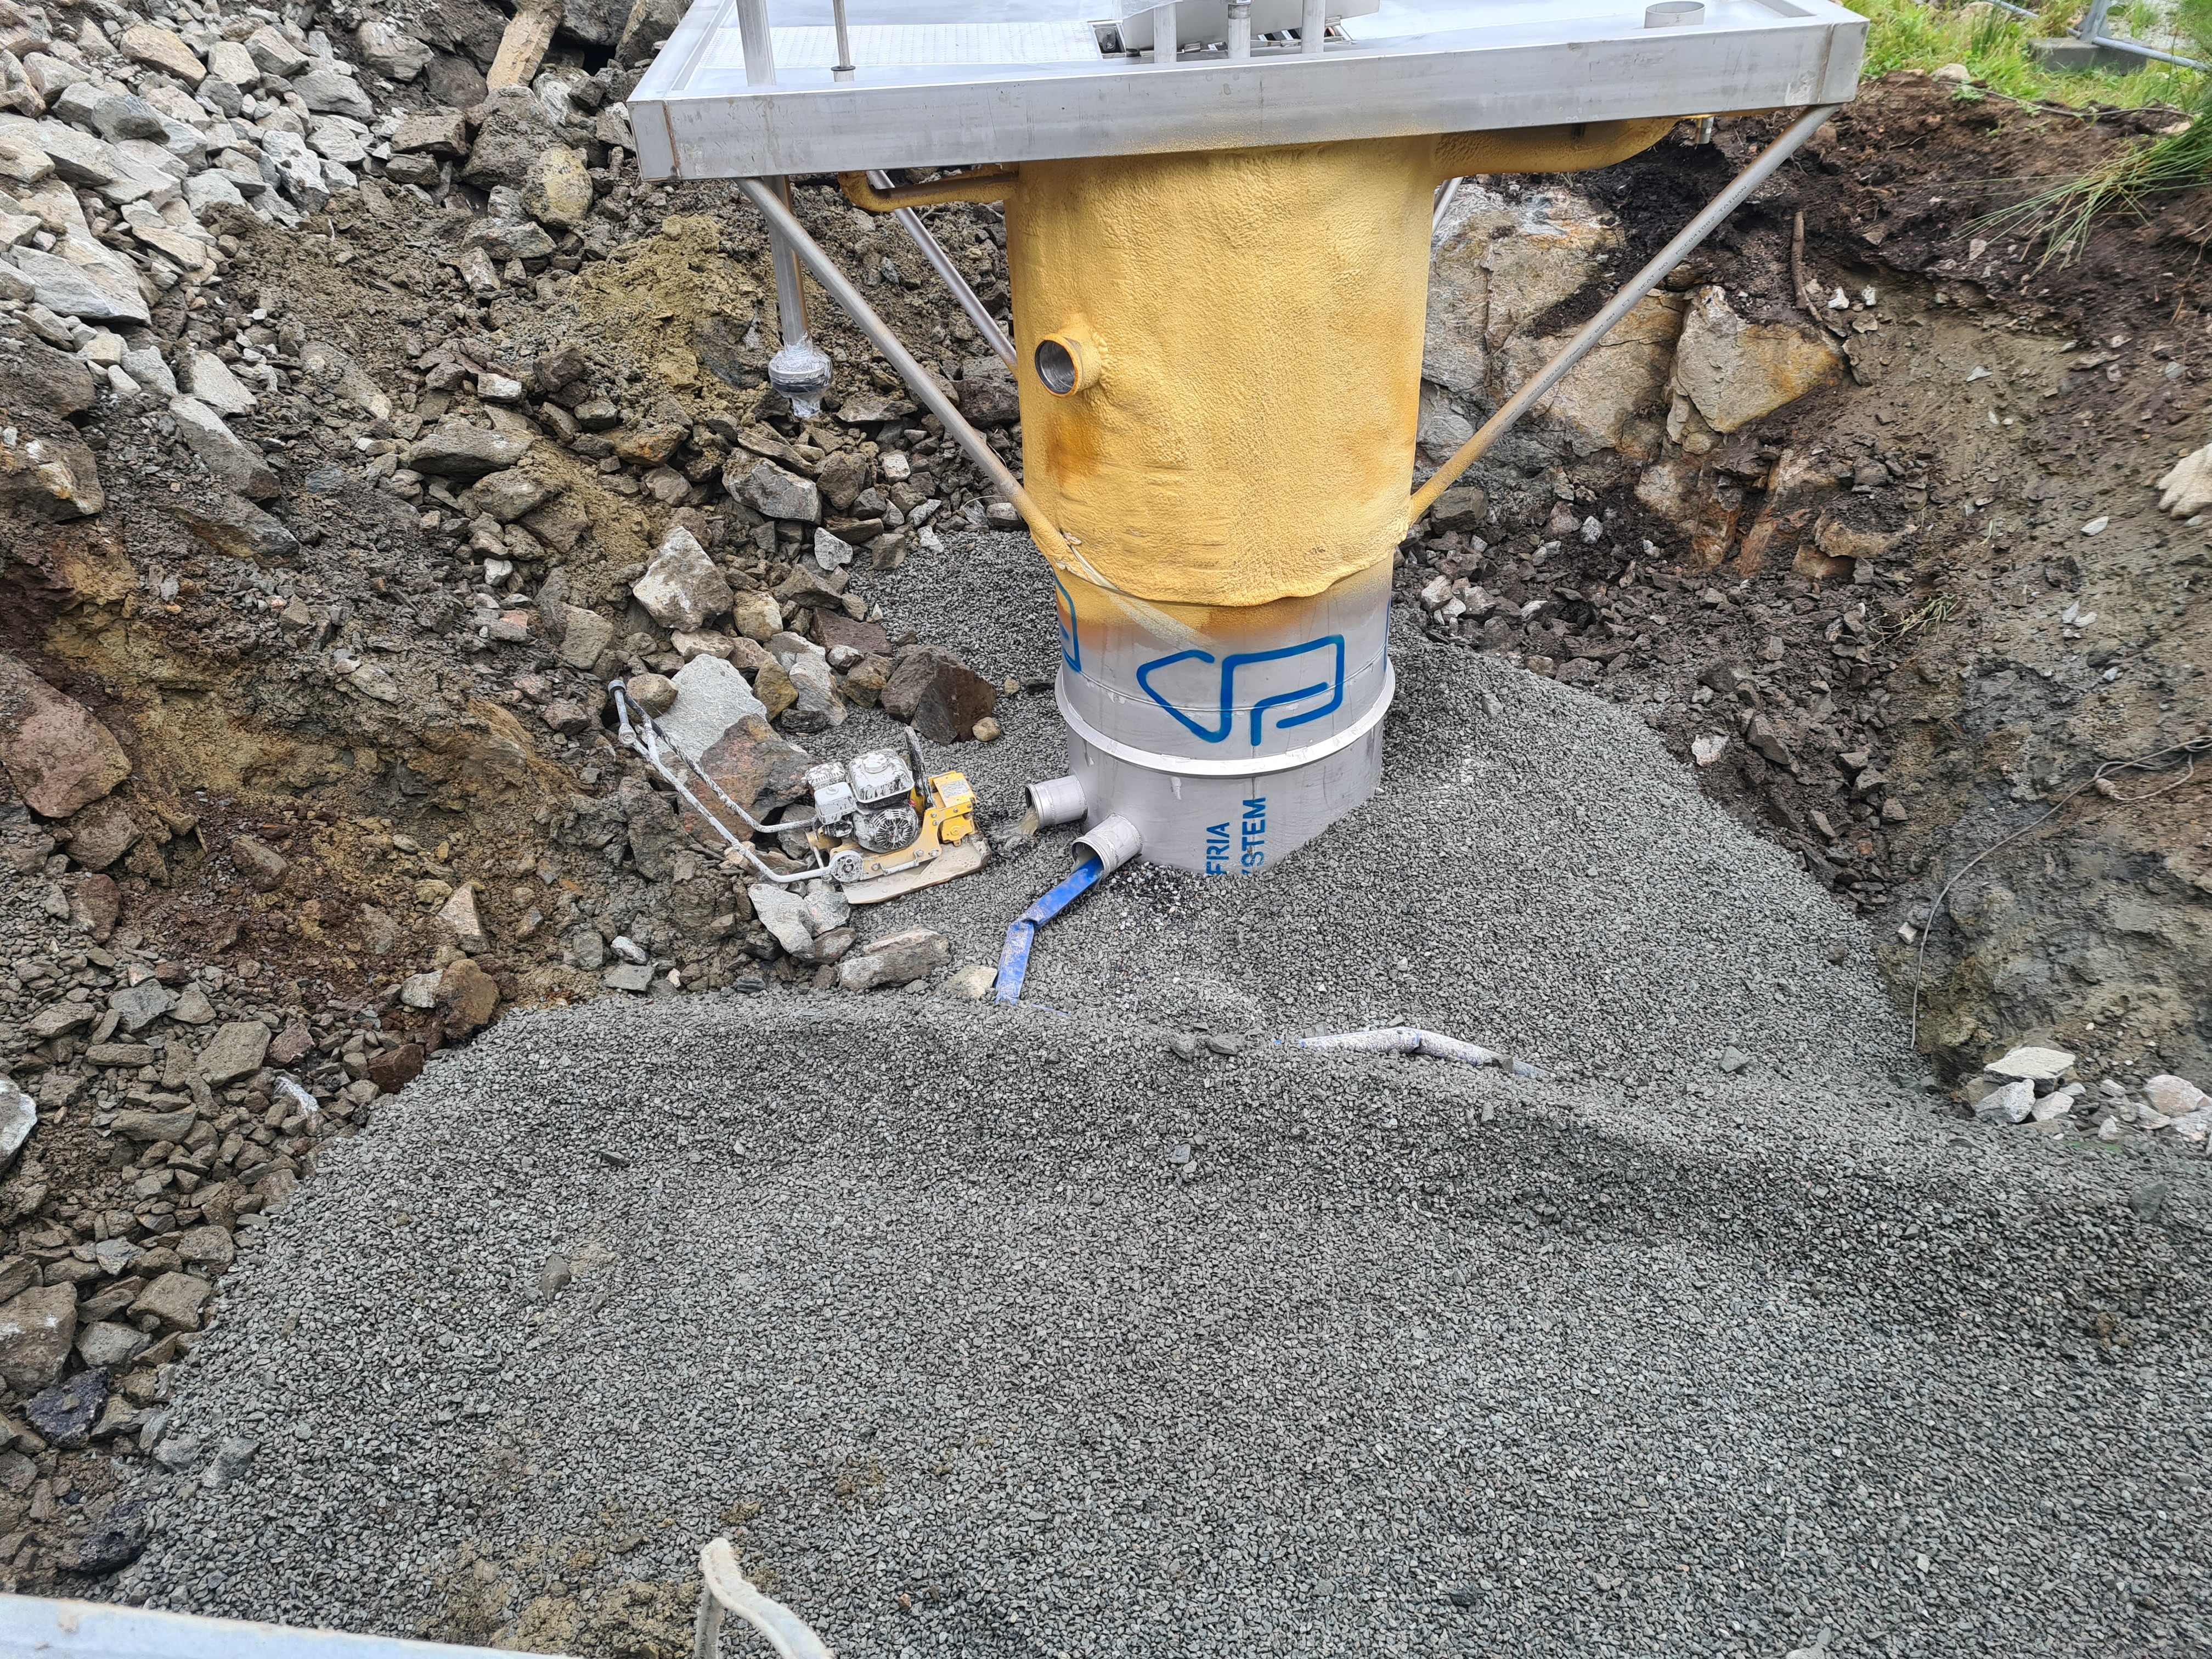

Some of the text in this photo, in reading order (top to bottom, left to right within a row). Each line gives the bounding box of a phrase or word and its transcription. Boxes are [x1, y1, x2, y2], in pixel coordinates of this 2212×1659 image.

[1637, 273, 1656, 291] HEAT
[1658, 261, 1668, 271] NO
[1718, 185, 1747, 213] TAIWAN
[1206, 822, 1230, 875] FRIA
